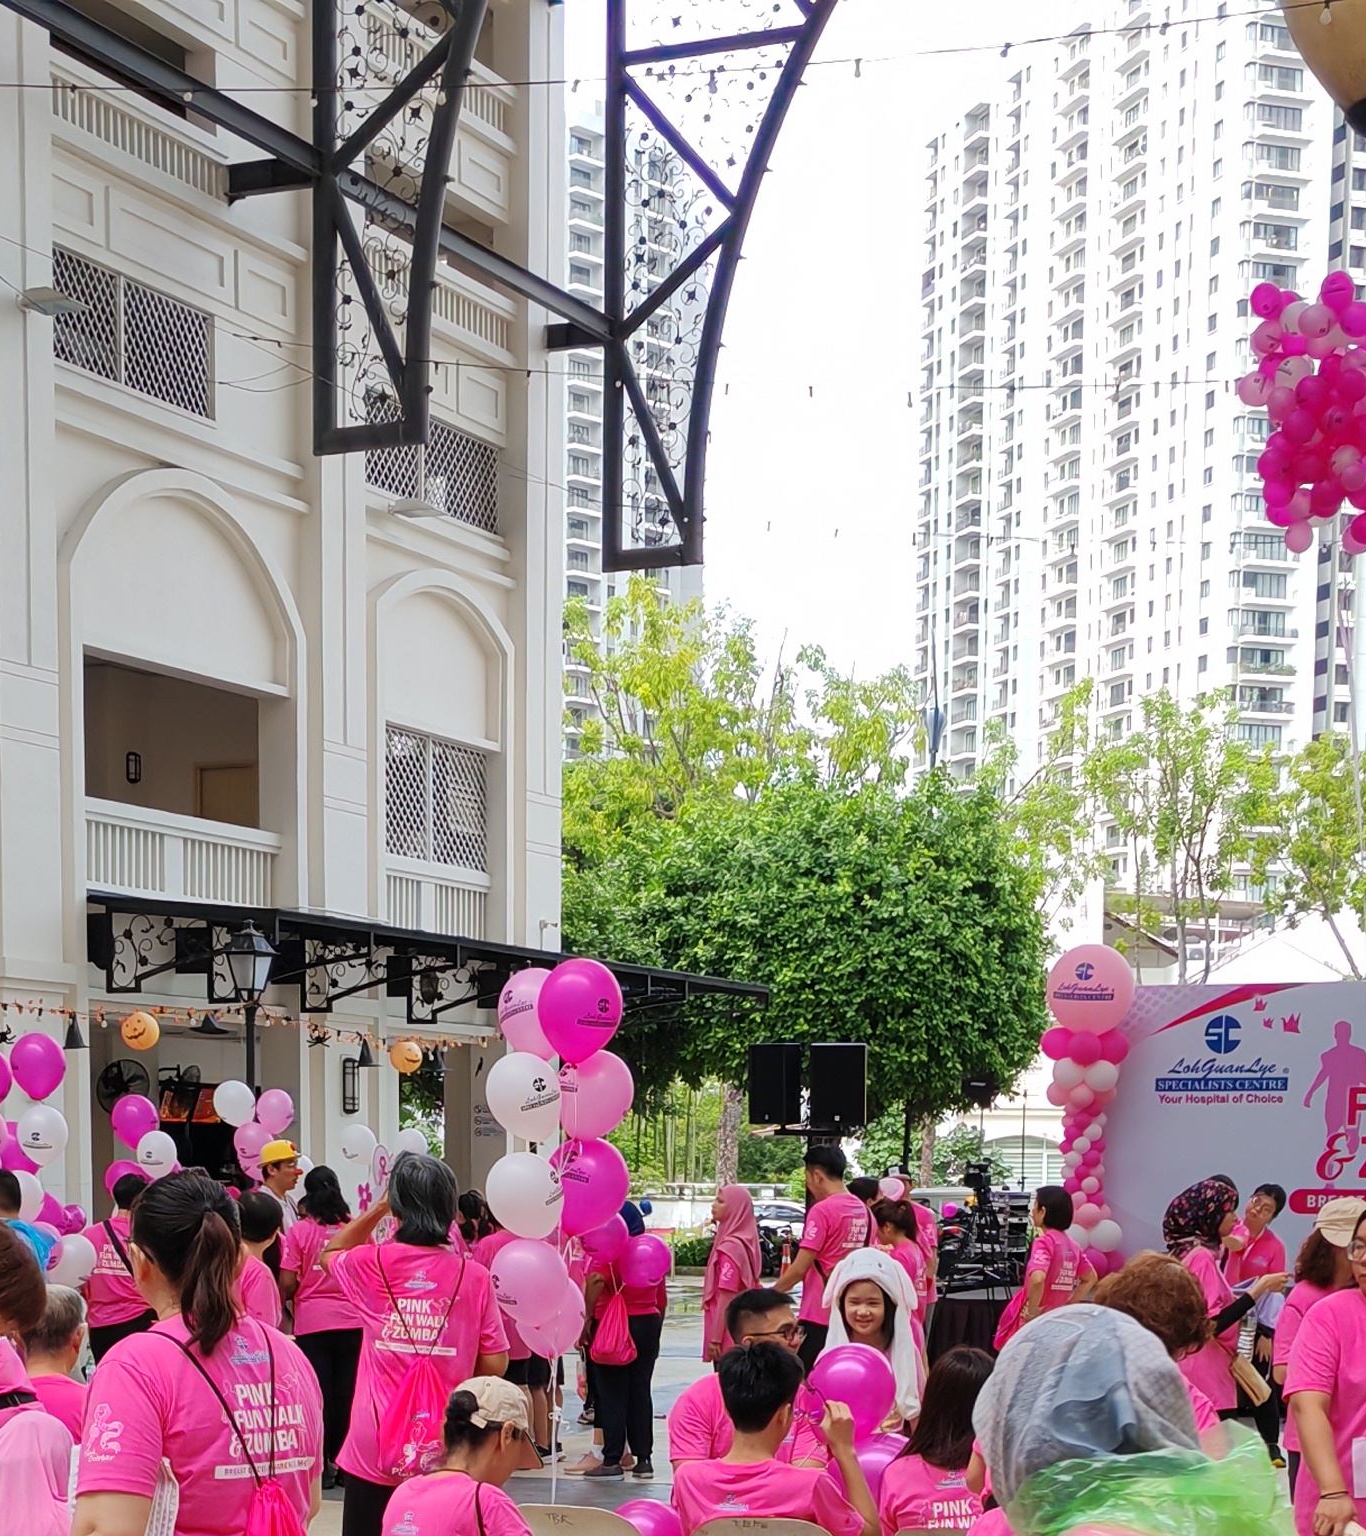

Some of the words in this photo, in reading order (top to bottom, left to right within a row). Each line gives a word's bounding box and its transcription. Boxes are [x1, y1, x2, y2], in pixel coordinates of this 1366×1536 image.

[1167, 1058, 1277, 1078] LohGuanLye
[1157, 1079, 1233, 1090] SPECIALISTS
[1236, 1079, 1286, 1090] CENTRE
[1158, 1094, 1183, 1104] Your
[1186, 1094, 1229, 1104] Hospital
[1233, 1094, 1244, 1103] of
[1246, 1094, 1284, 1104] Choice
[1316, 1133, 1356, 1181] &
[398, 1298, 432, 1314] PINK
[391, 1313, 414, 1327] FUN
[415, 1314, 449, 1329] WALK
[392, 1326, 439, 1342] ZUMBA
[235, 1383, 280, 1407] PINK
[234, 1409, 263, 1430] FUN
[933, 1499, 972, 1518] PINK
